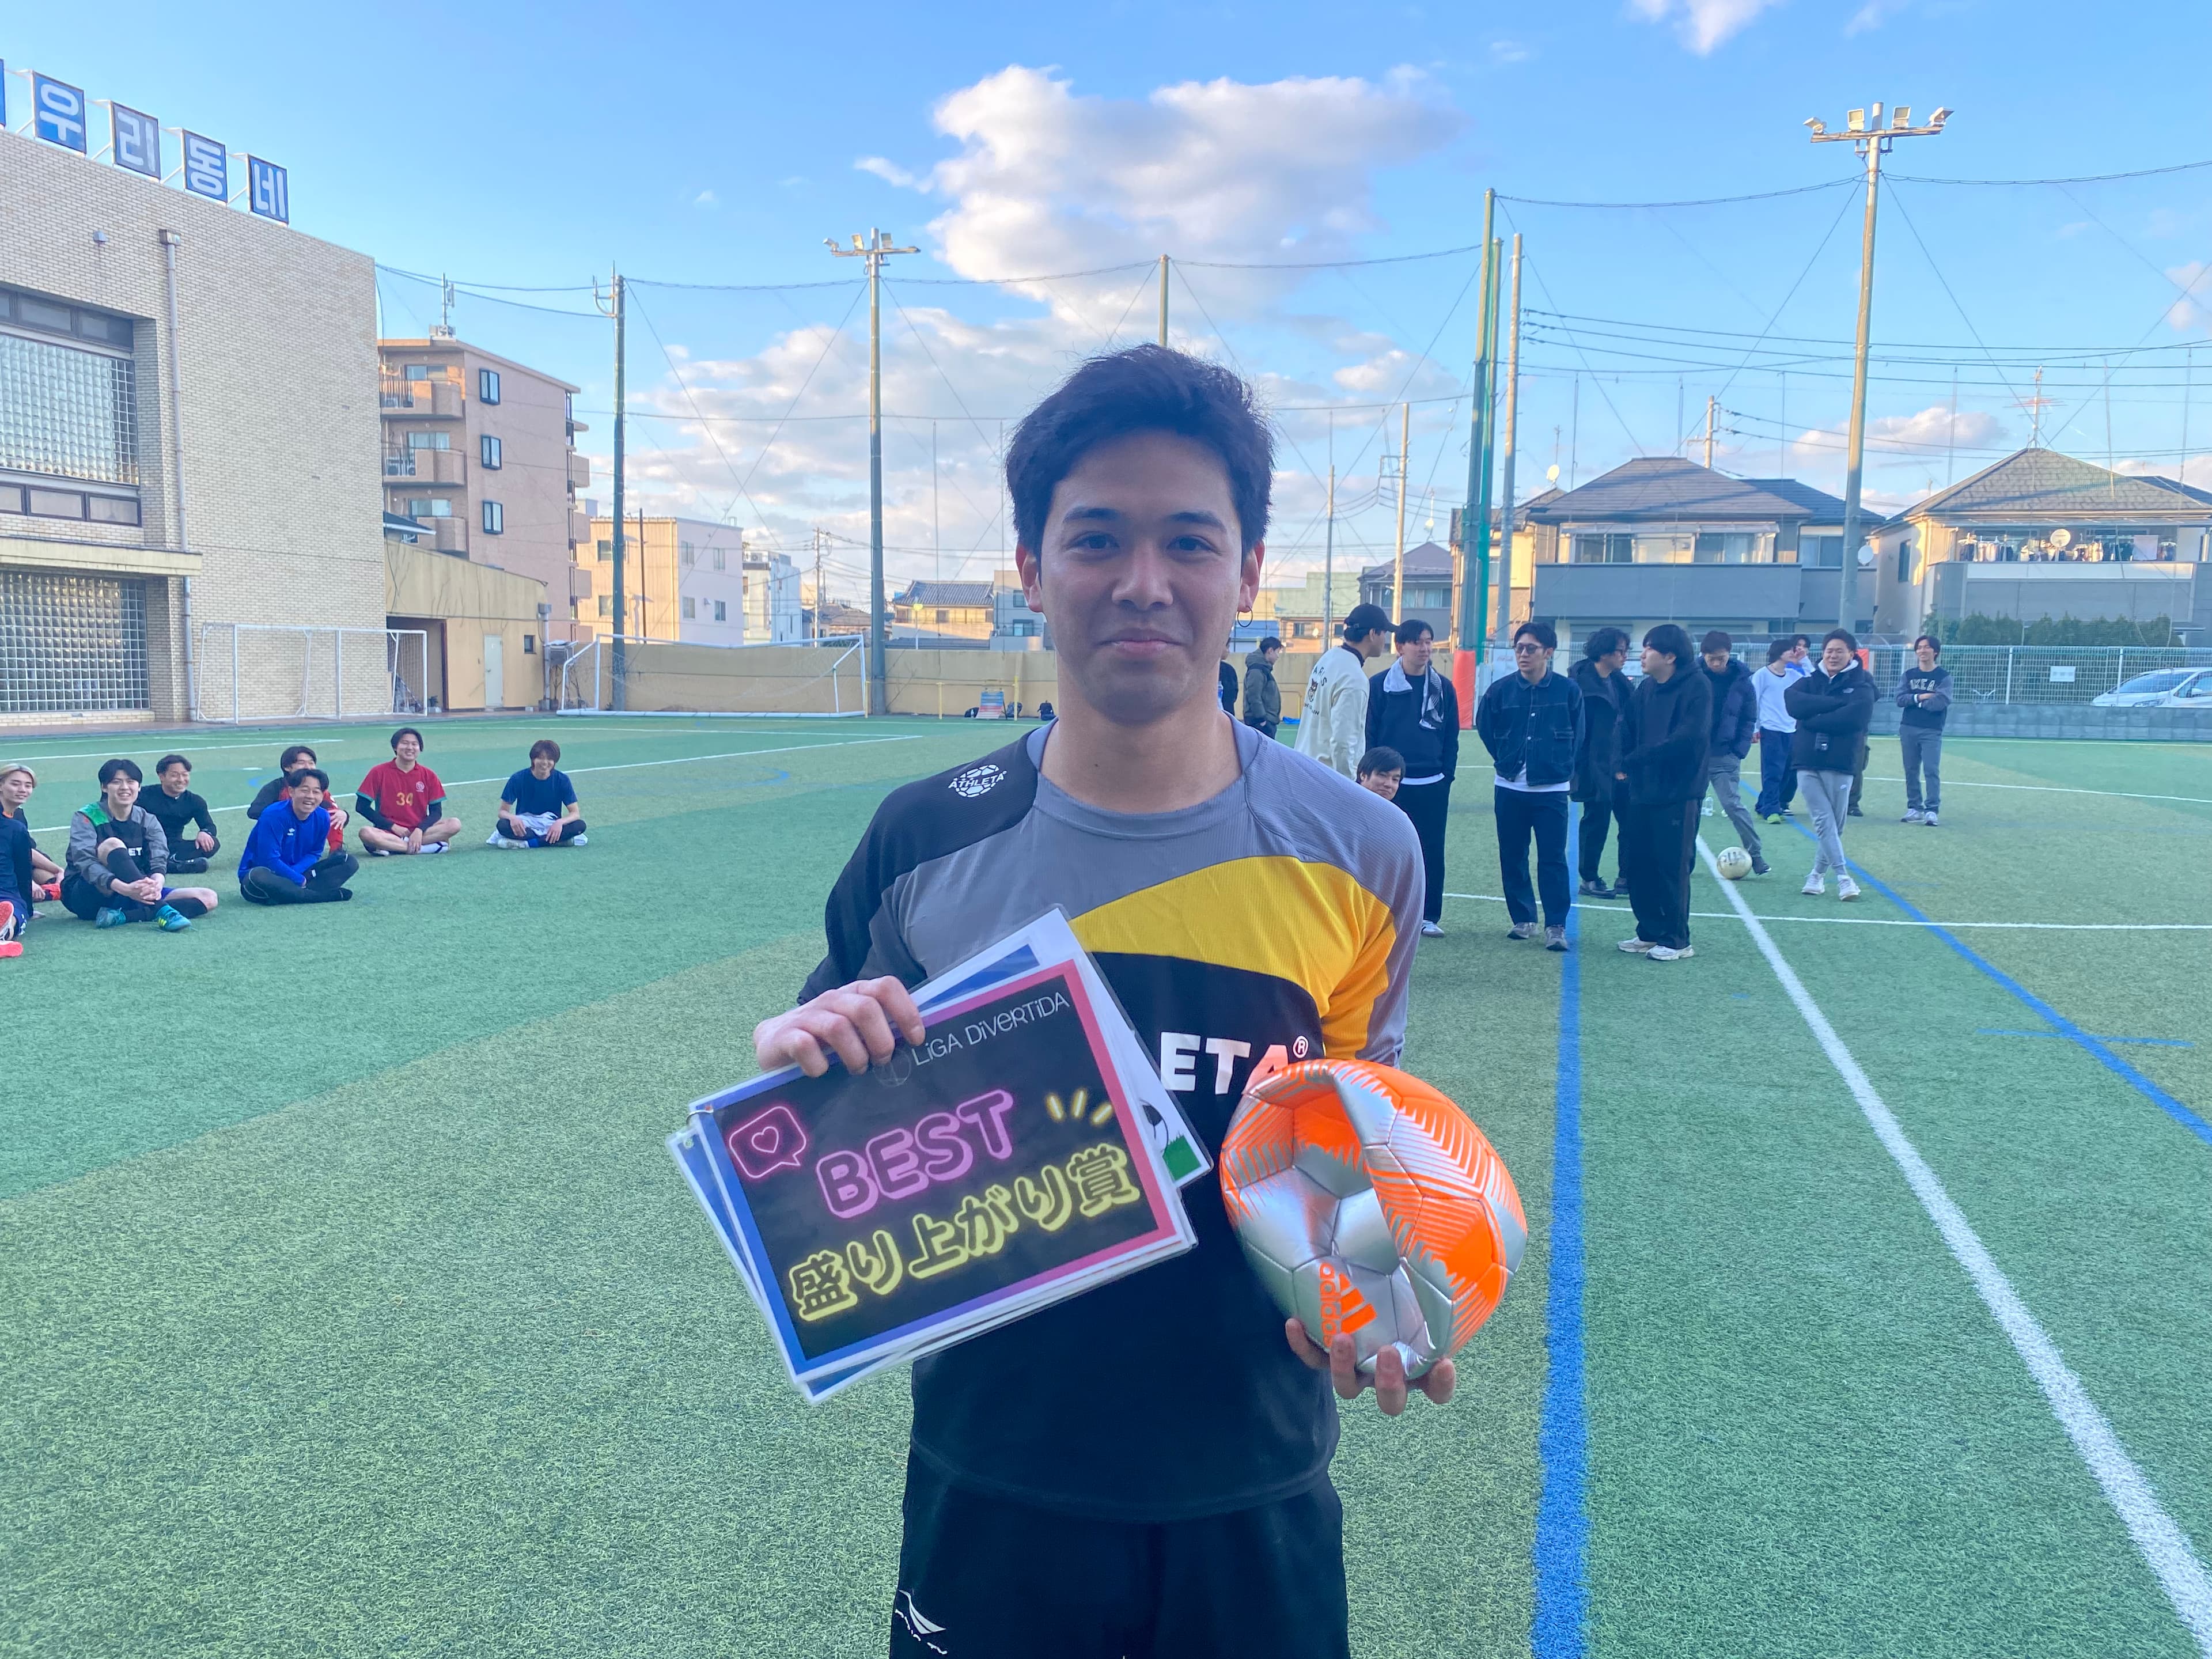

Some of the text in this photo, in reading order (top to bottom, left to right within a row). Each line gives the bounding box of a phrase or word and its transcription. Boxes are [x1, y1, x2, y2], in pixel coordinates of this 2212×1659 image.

[396, 792, 414, 806] 34
[948, 772, 1005, 789] ATHLETA
[816, 1089, 1014, 1219] BEST
[789, 1143, 1141, 1321] 盛り上がり賞
